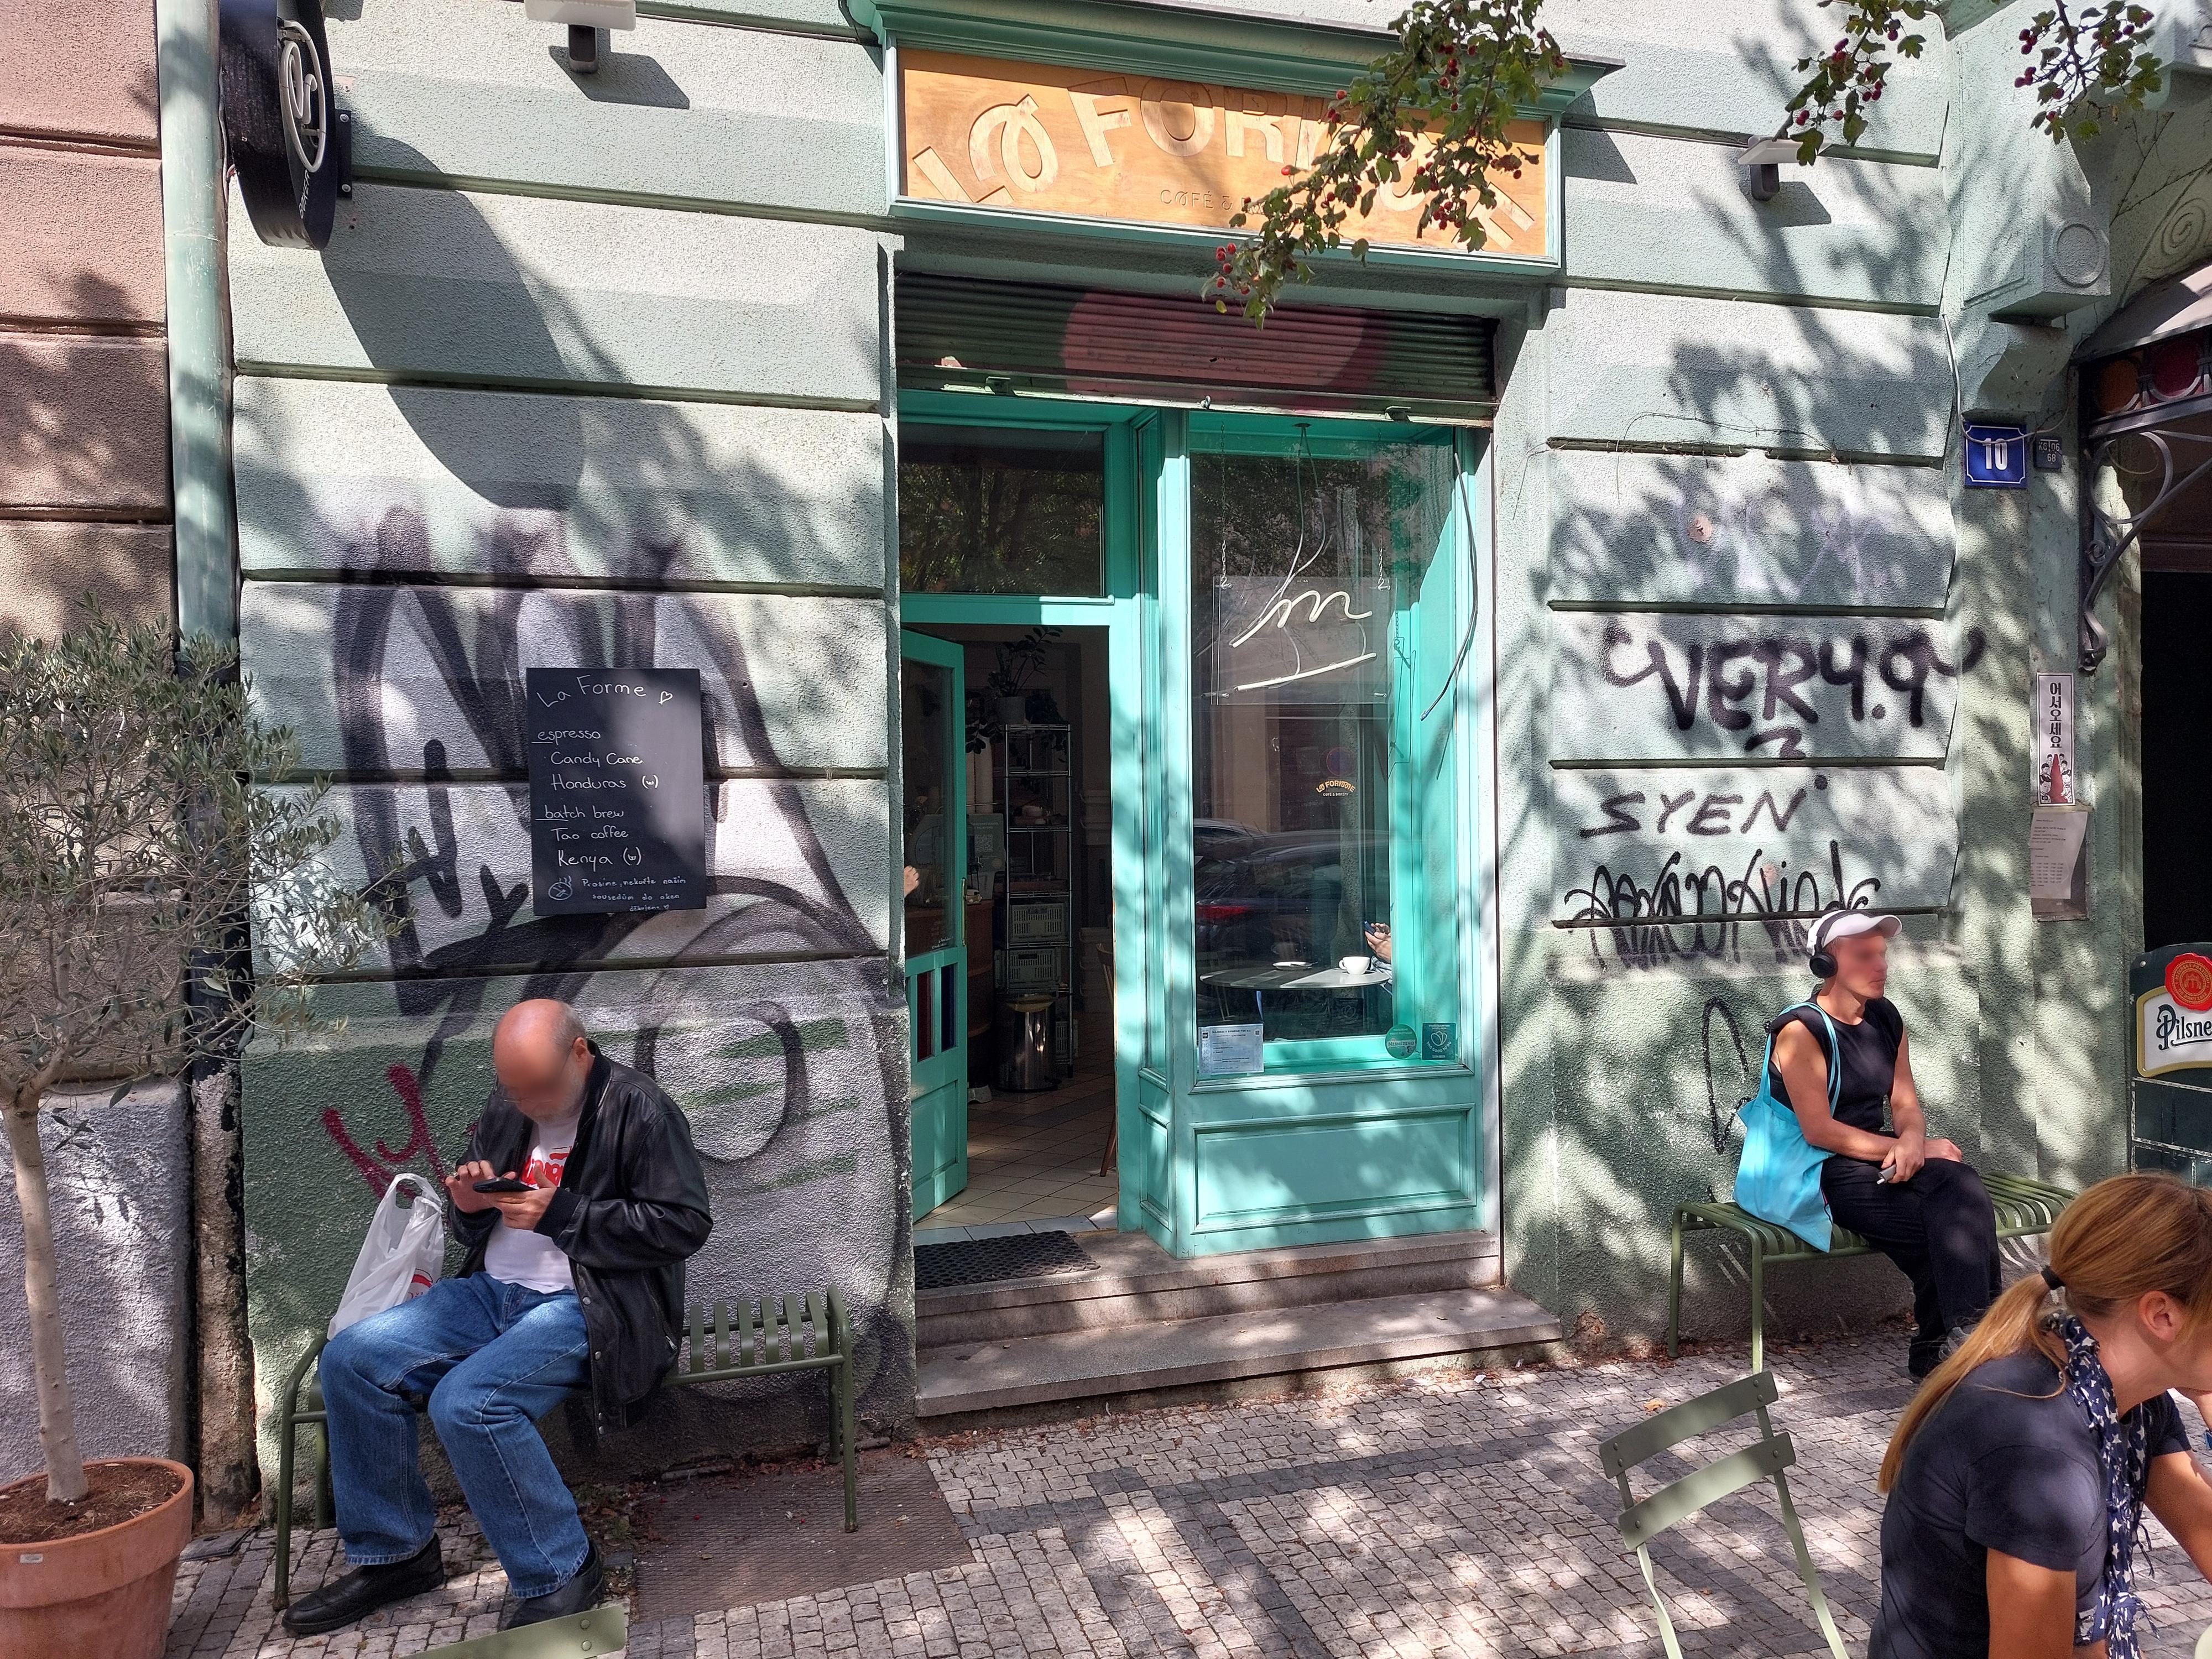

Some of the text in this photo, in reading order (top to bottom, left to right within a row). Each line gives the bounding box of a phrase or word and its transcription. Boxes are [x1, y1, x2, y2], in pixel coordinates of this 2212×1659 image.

[1984, 437, 2008, 470] 10
[536, 674, 648, 708] La Forme
[2049, 682, 2062, 748] 어서오세요
[537, 729, 601, 746] espresso
[550, 751, 644, 768] Candy Cane
[550, 773, 627, 791] Honduras
[544, 805, 624, 819] batch brew
[550, 825, 629, 841] Tao coffee
[557, 849, 613, 872] Kenya
[641, 893, 653, 901] do
